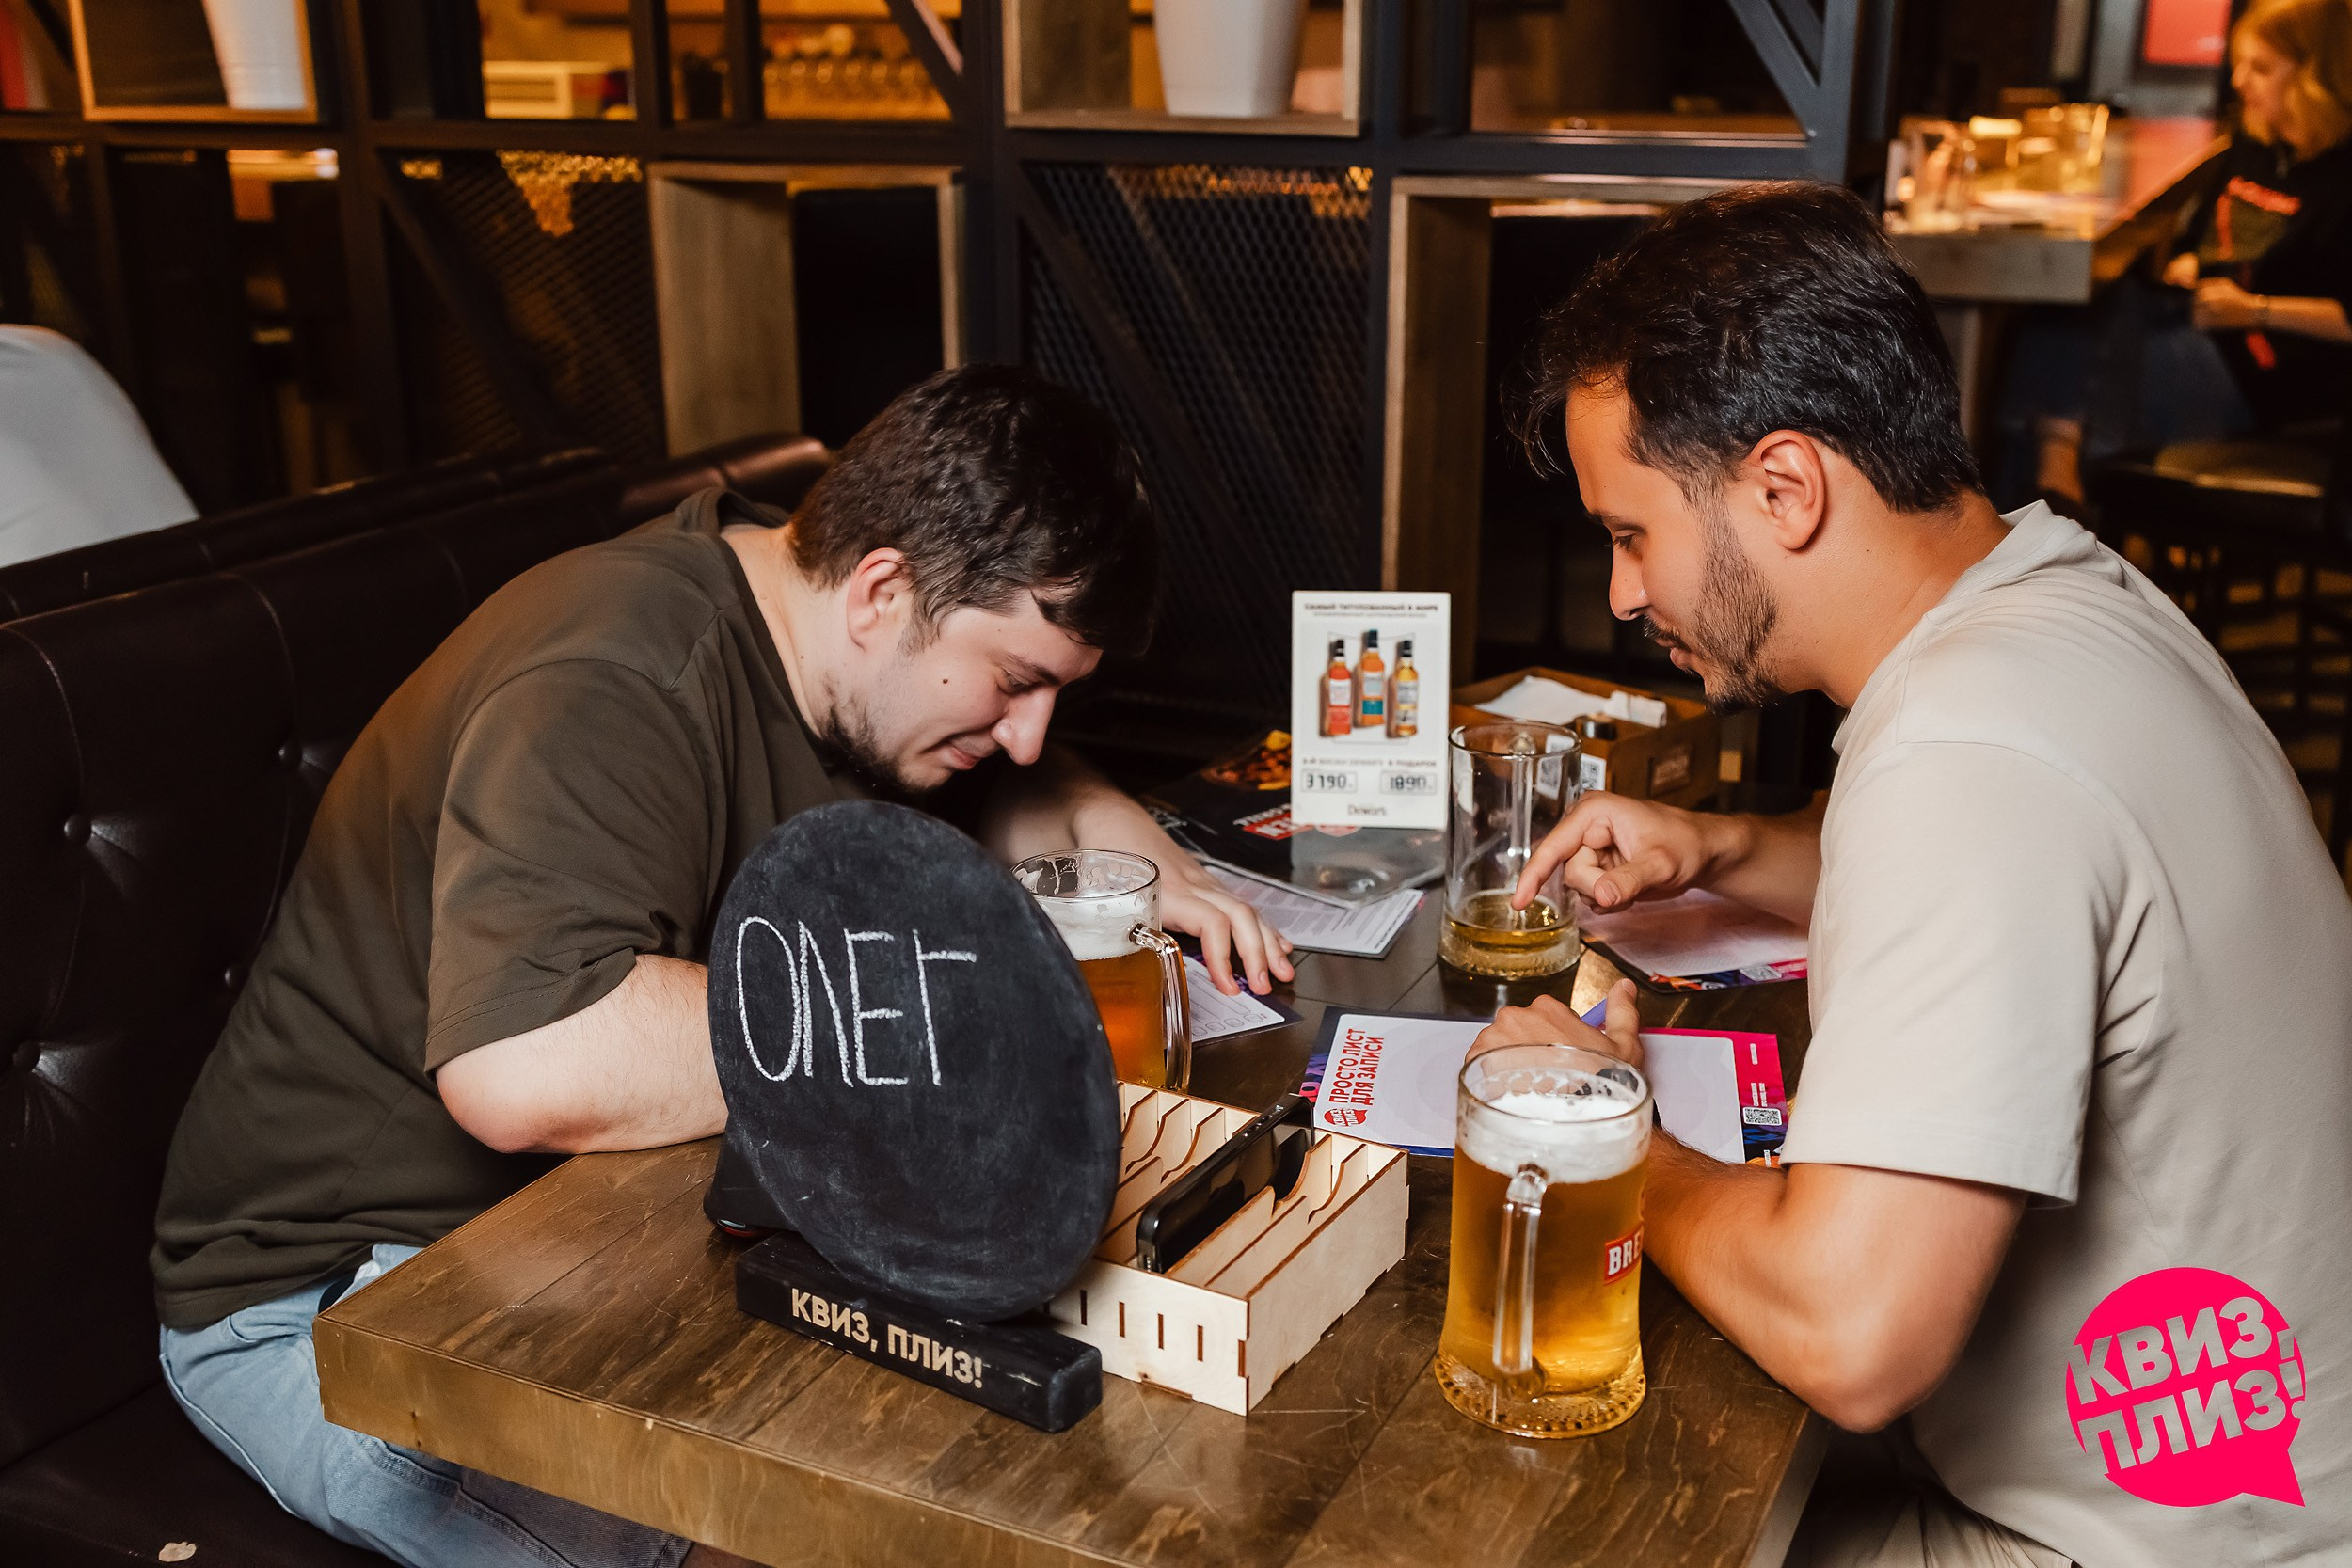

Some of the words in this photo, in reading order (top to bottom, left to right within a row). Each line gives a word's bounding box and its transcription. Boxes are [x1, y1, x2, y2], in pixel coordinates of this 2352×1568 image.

[737, 916, 977, 1088] ОЛЕГ
[1343, 1028, 1366, 1056] ЛИСТ
[1357, 1037, 1385, 1079] ЗАПИСИ
[1328, 1058, 1359, 1103] ПРОСТО
[1350, 1082, 1375, 1106] ДЛЯ
[791, 1288, 879, 1353] КВИЗ,
[887, 1323, 983, 1389] ПЛИЗ!
